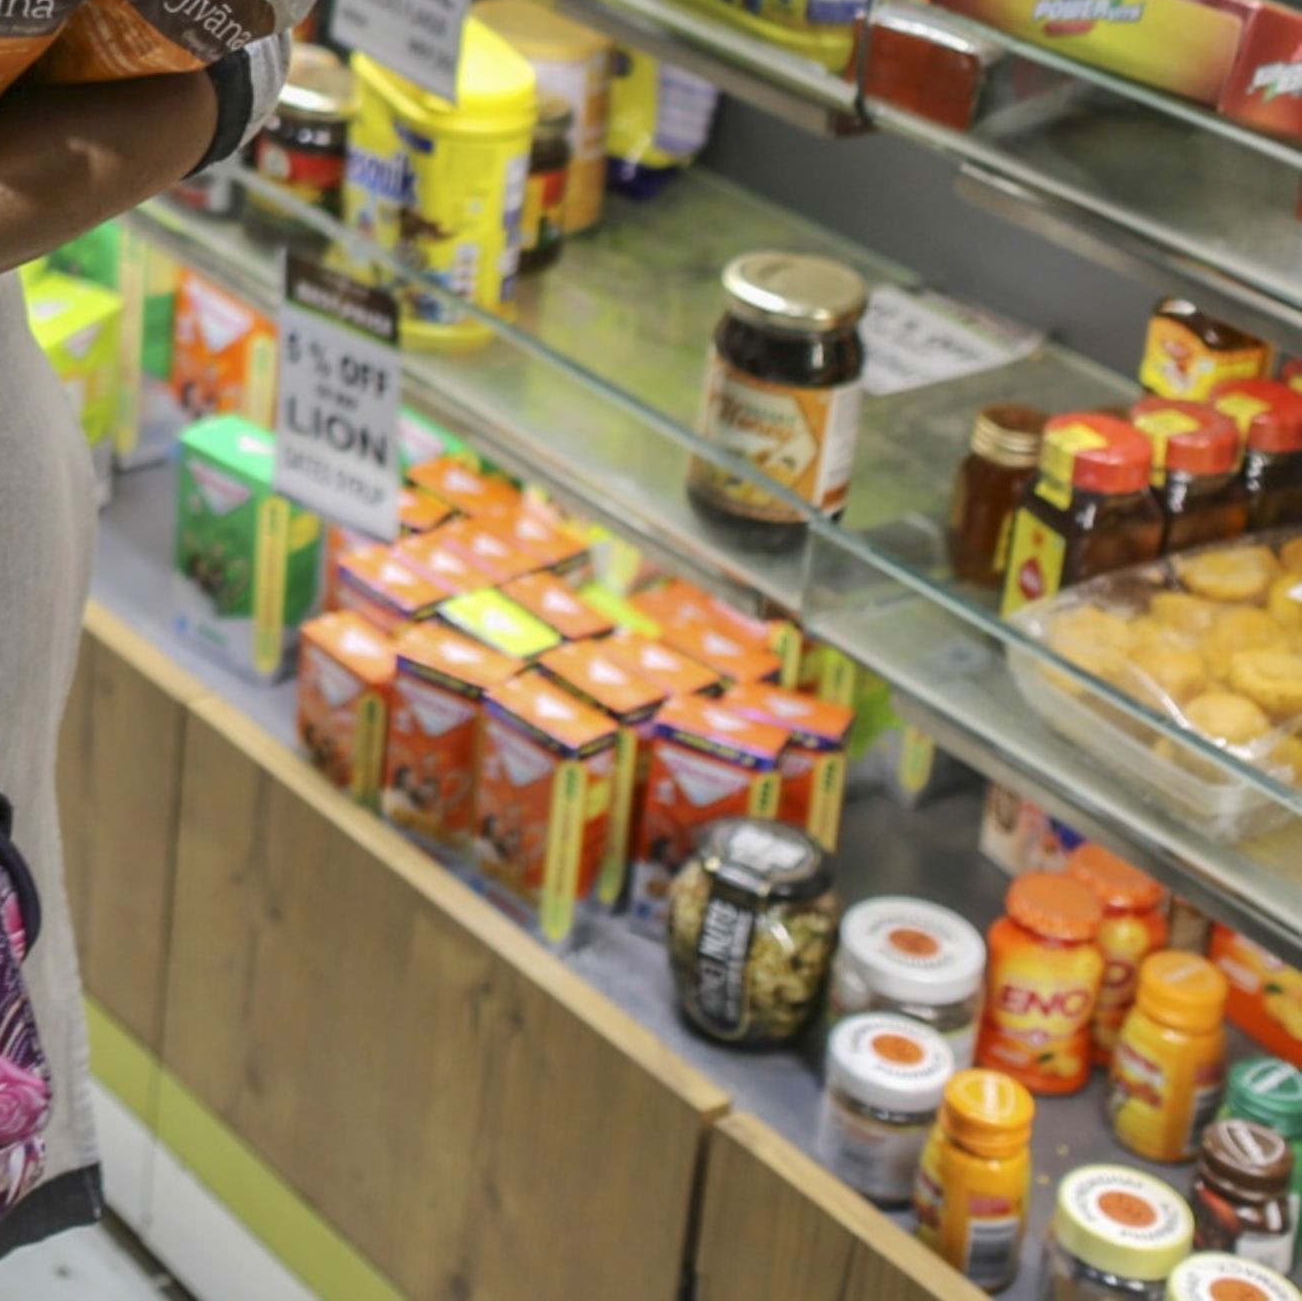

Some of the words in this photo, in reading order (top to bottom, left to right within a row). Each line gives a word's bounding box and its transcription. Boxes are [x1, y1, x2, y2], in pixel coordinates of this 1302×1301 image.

[340, 350, 390, 397] OFF
[286, 398, 390, 469] LION
[1000, 982, 1091, 1018] ENO
